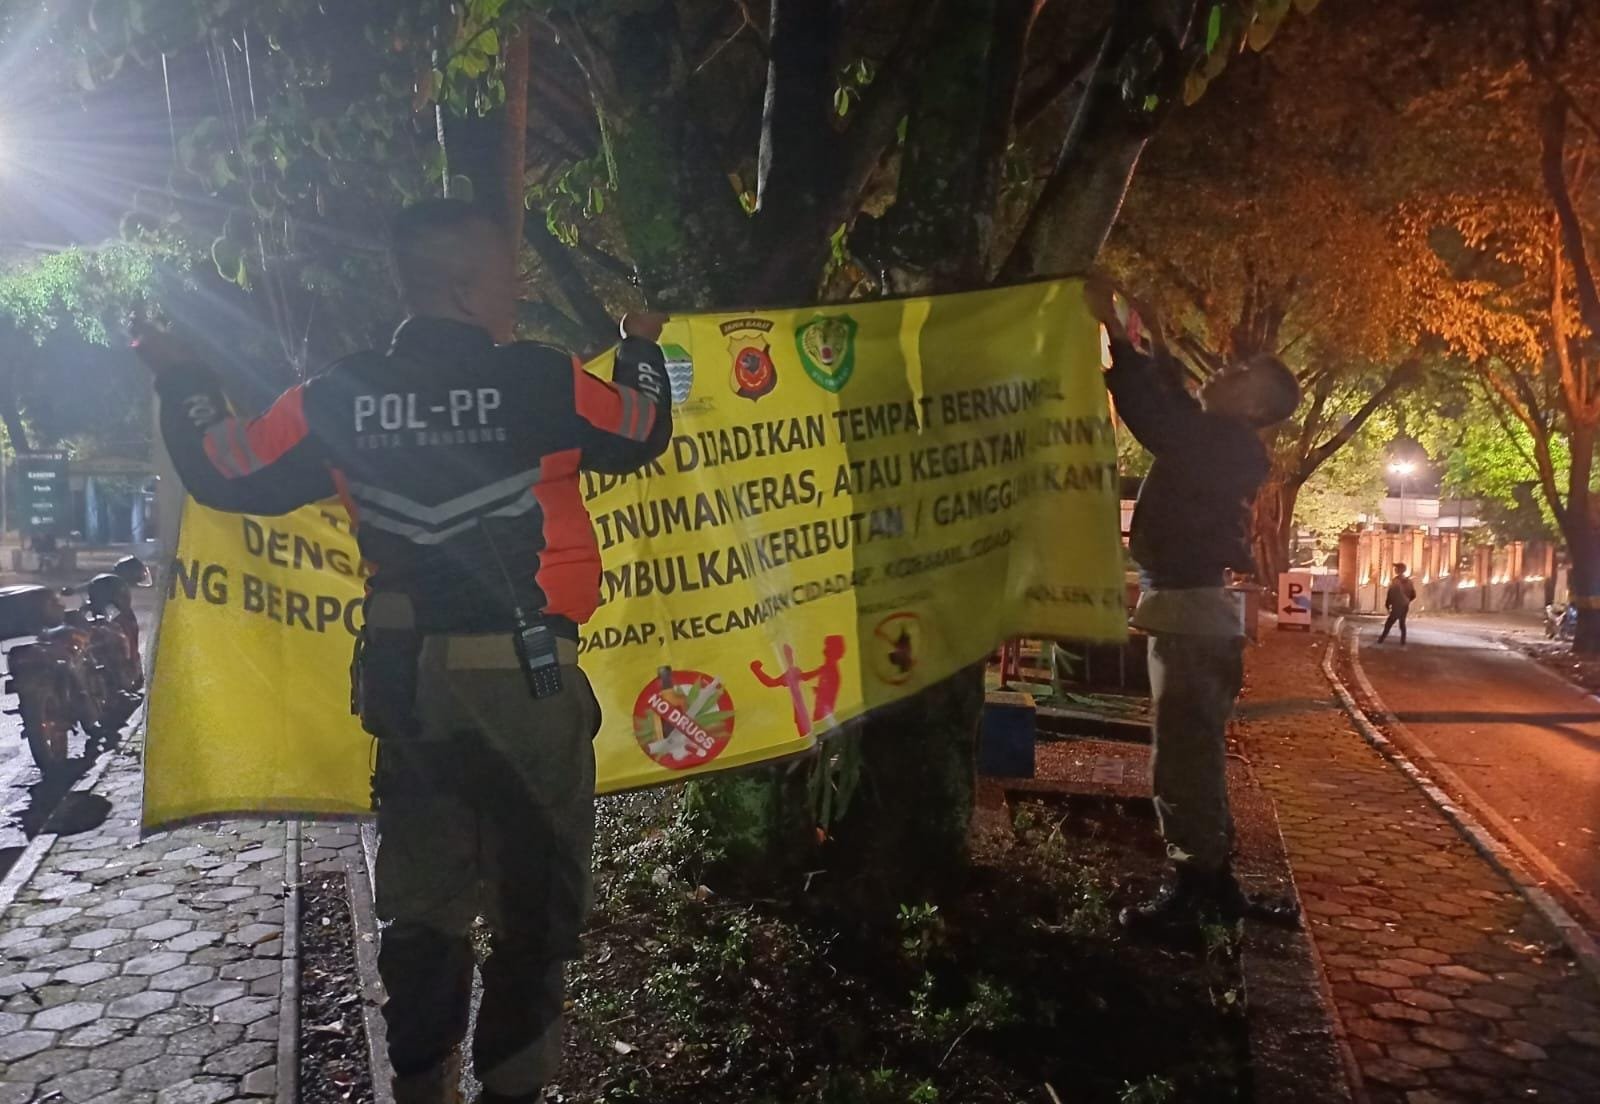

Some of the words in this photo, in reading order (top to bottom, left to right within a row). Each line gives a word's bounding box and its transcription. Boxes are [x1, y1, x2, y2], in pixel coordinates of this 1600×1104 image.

[354, 388, 500, 432] POL-PP
[673, 414, 826, 473] DIJADIKAN
[832, 398, 935, 445] TEMPAT
[732, 469, 823, 520] KERAS,
[834, 456, 901, 497] ATAU
[911, 428, 1027, 482] KEGIATAN
[1288, 583, 1303, 599] P
[647, 693, 669, 714] NO
[668, 707, 715, 750] DRUGS
